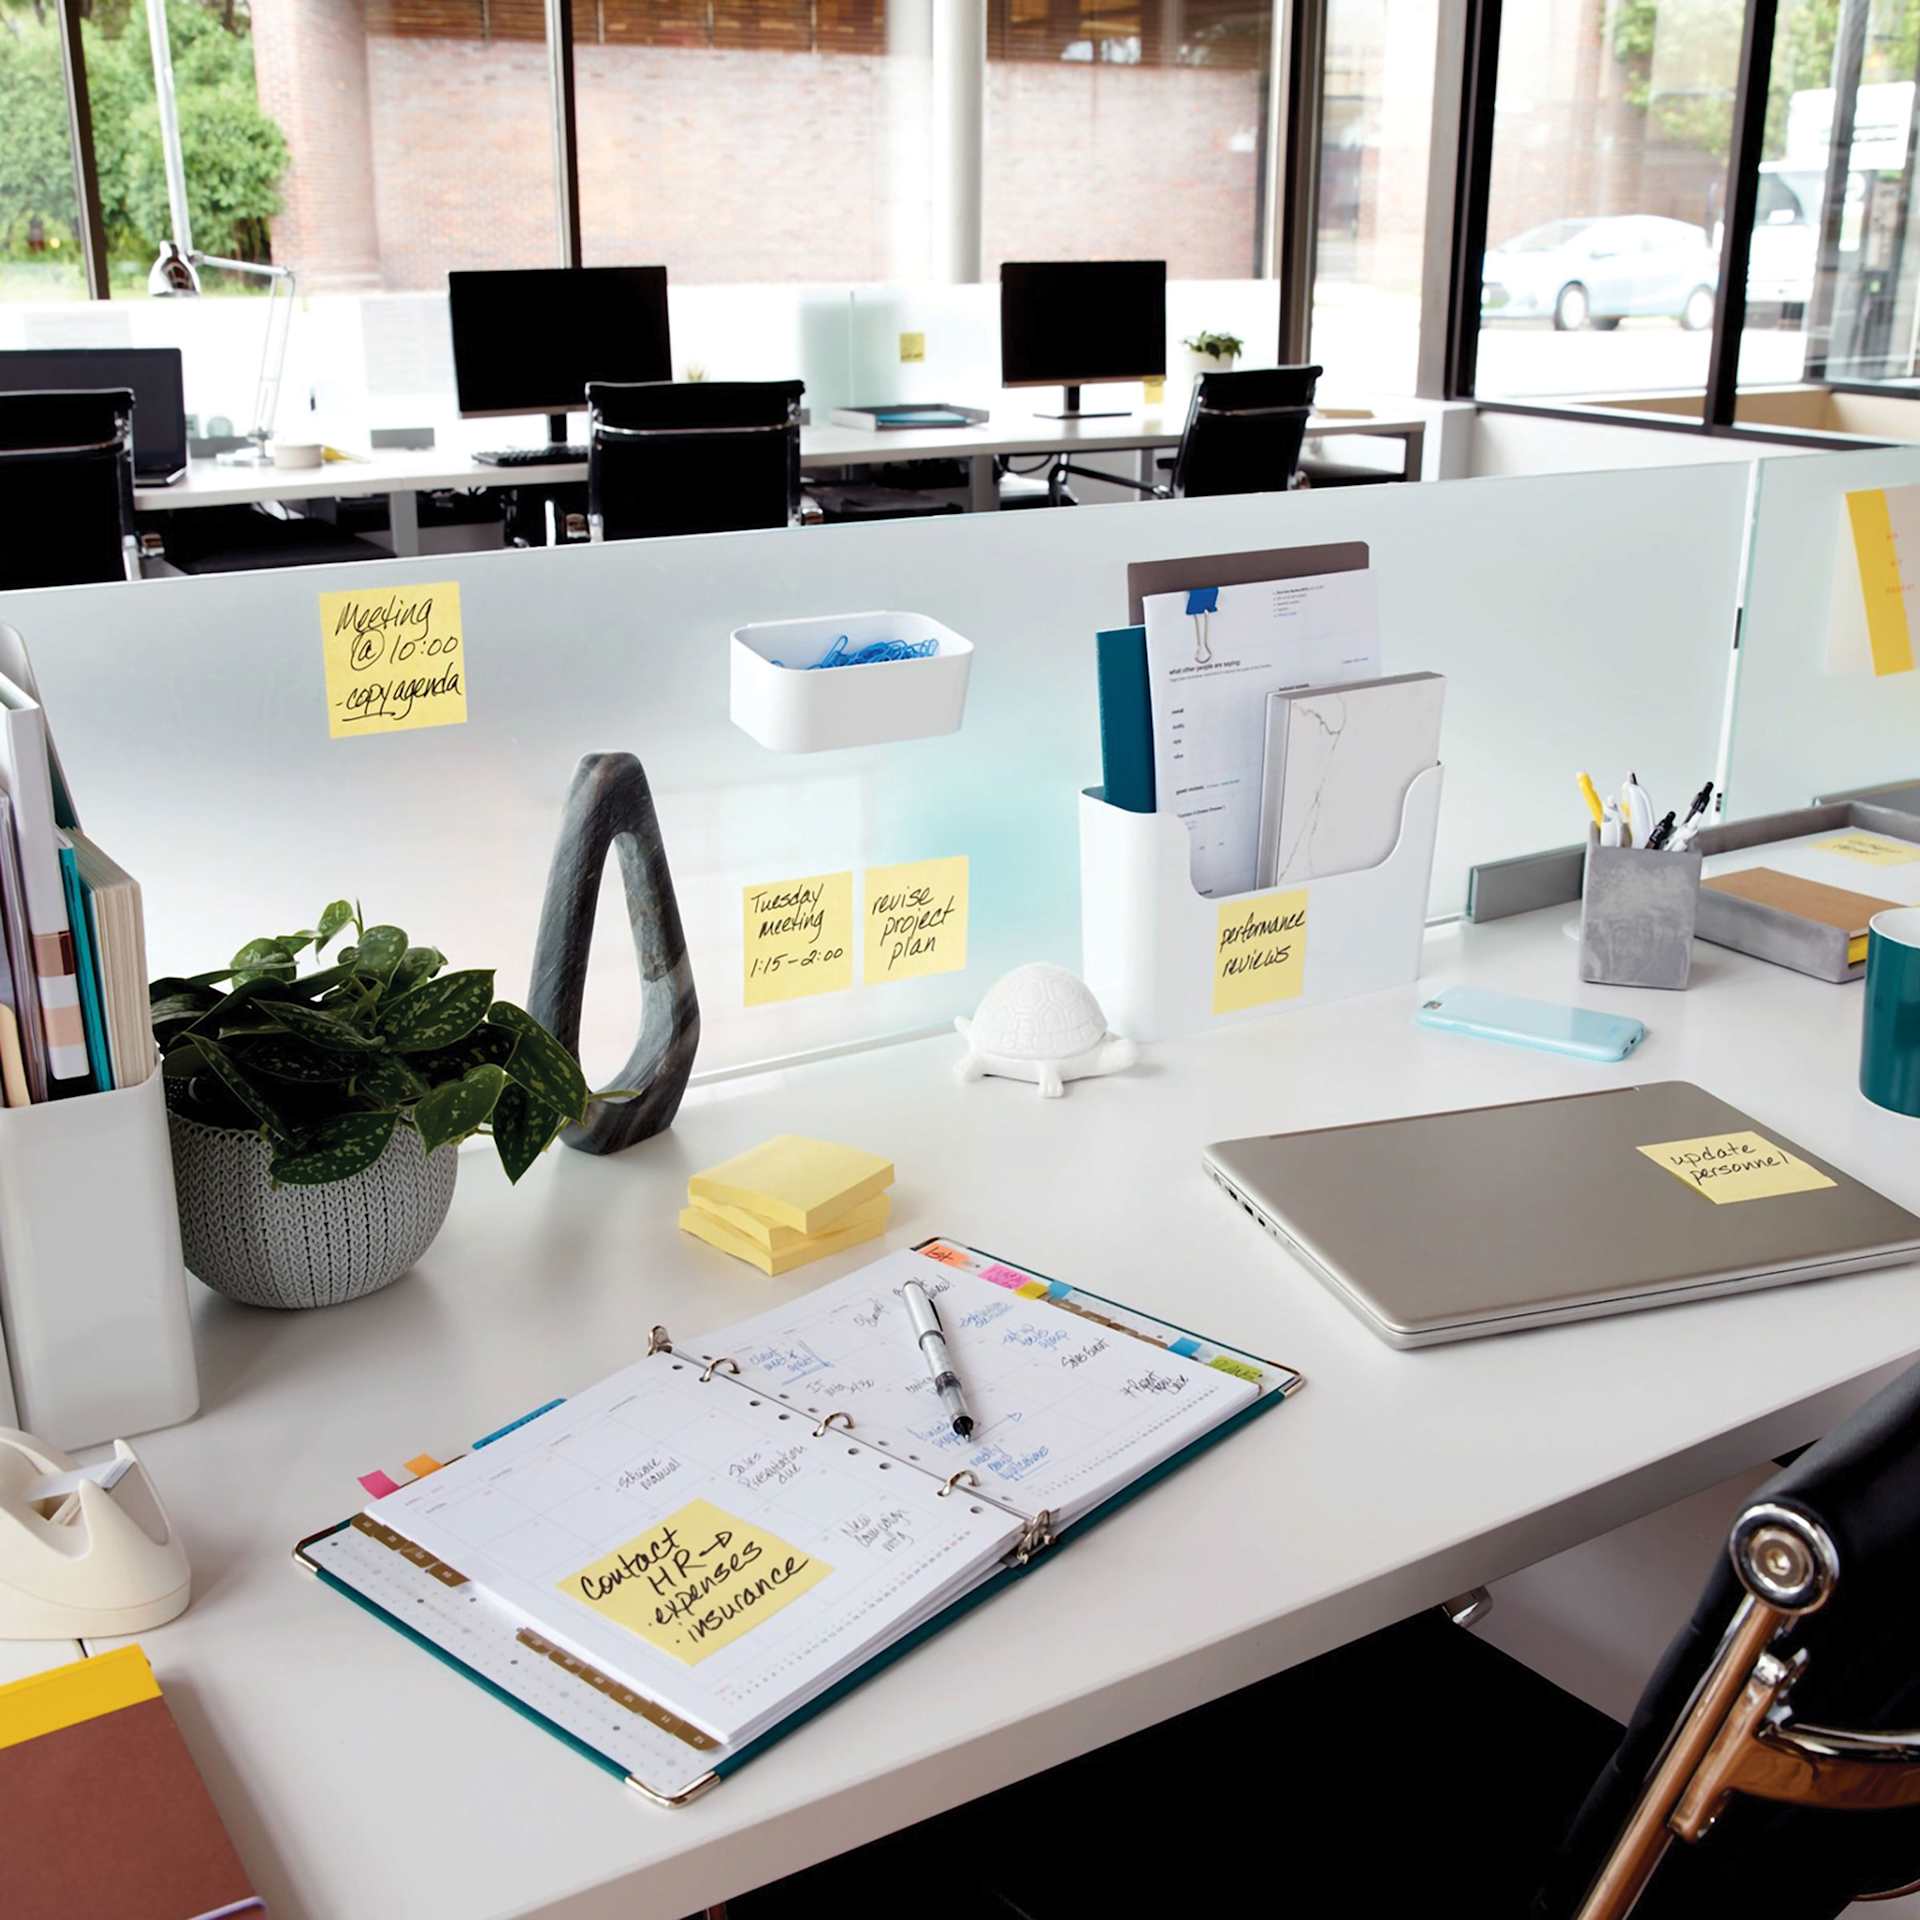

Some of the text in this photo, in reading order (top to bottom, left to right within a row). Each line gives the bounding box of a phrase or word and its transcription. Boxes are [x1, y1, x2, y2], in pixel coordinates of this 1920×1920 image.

[335, 594, 434, 642] Meeting
[389, 634, 459, 665] 10:00
[750, 883, 825, 914] Tuesday
[871, 886, 935, 916] revise
[757, 909, 825, 944] meeting
[879, 895, 956, 947] project
[887, 936, 937, 971] plan
[1221, 945, 1292, 978] reviews
[1669, 1142, 1757, 1168] update
[1689, 1151, 1790, 1186] personnel
[579, 1526, 681, 1601] Contact
[648, 1548, 708, 1596] HR
